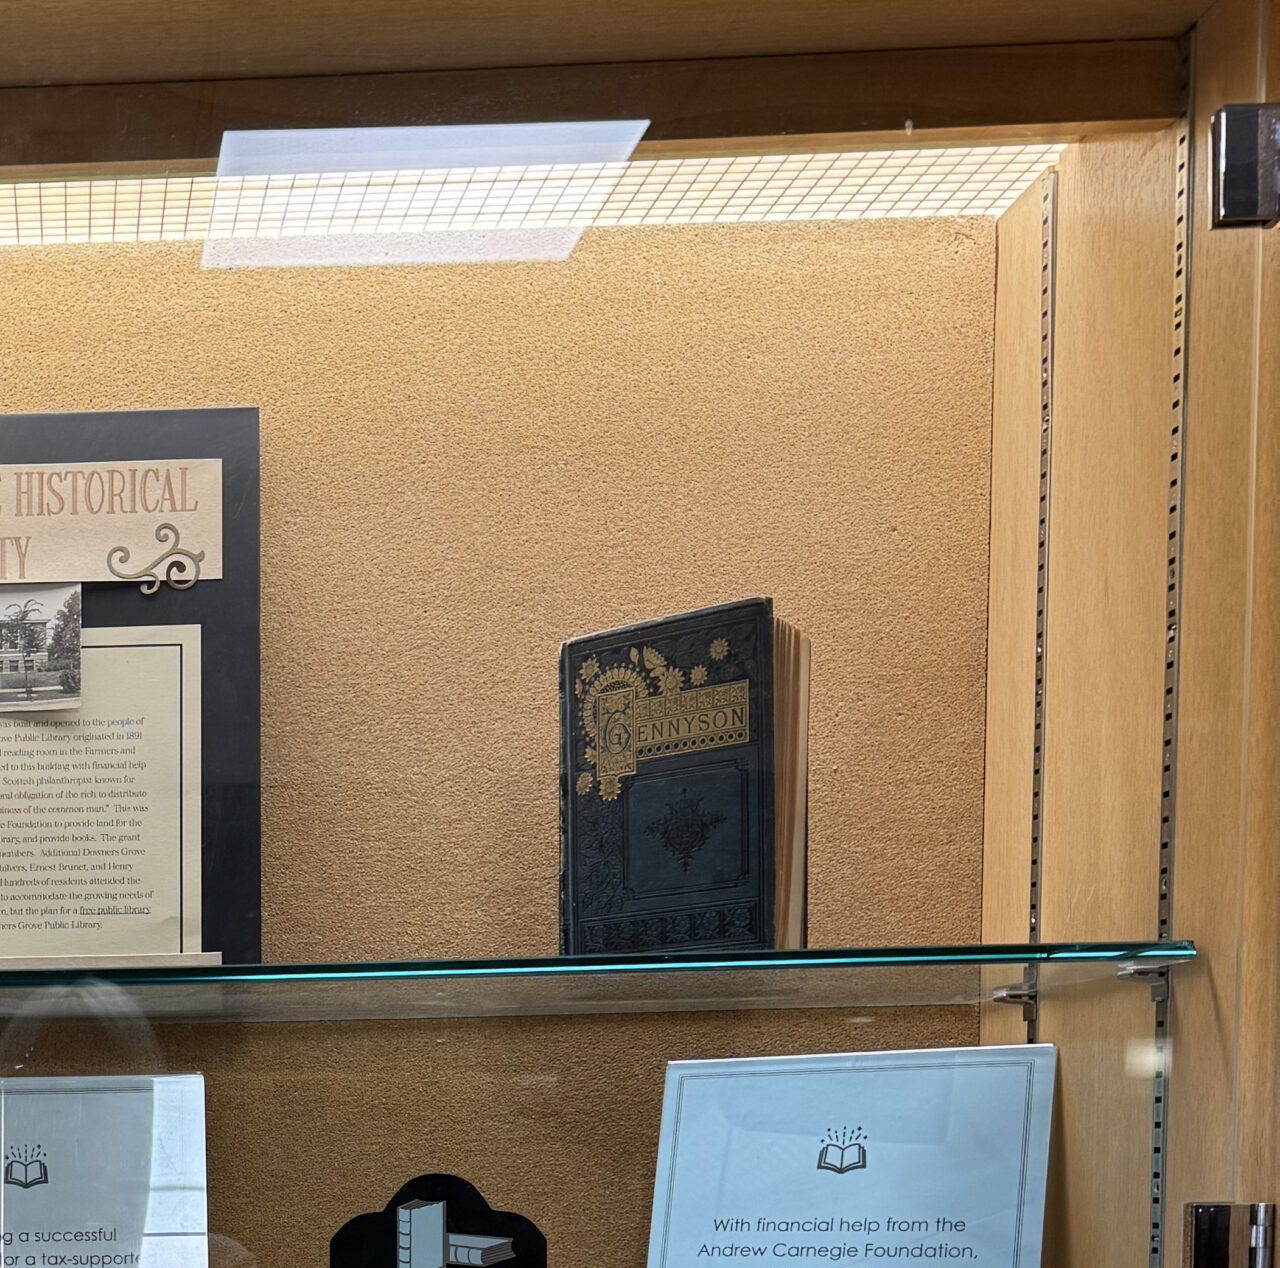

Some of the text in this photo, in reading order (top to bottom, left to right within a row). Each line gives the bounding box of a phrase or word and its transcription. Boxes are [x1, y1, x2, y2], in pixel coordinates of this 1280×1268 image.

[13, 466, 199, 517] HISTORICAL
[33, 719, 49, 727] and
[50, 718, 80, 730] opened
[82, 719, 91, 727] to
[92, 718, 106, 727] the
[107, 719, 135, 729] people
[136, 717, 146, 726] of
[18, 920, 43, 930] Grove
[44, 920, 70, 930] Public
[714, 1217, 966, 1235] With financial help from the
[19, 1231, 29, 1242] a
[34, 1228, 117, 1242] successful
[697, 1243, 978, 1261] Andrew Carnegie Foundation,
[25, 1255, 36, 1266] a
